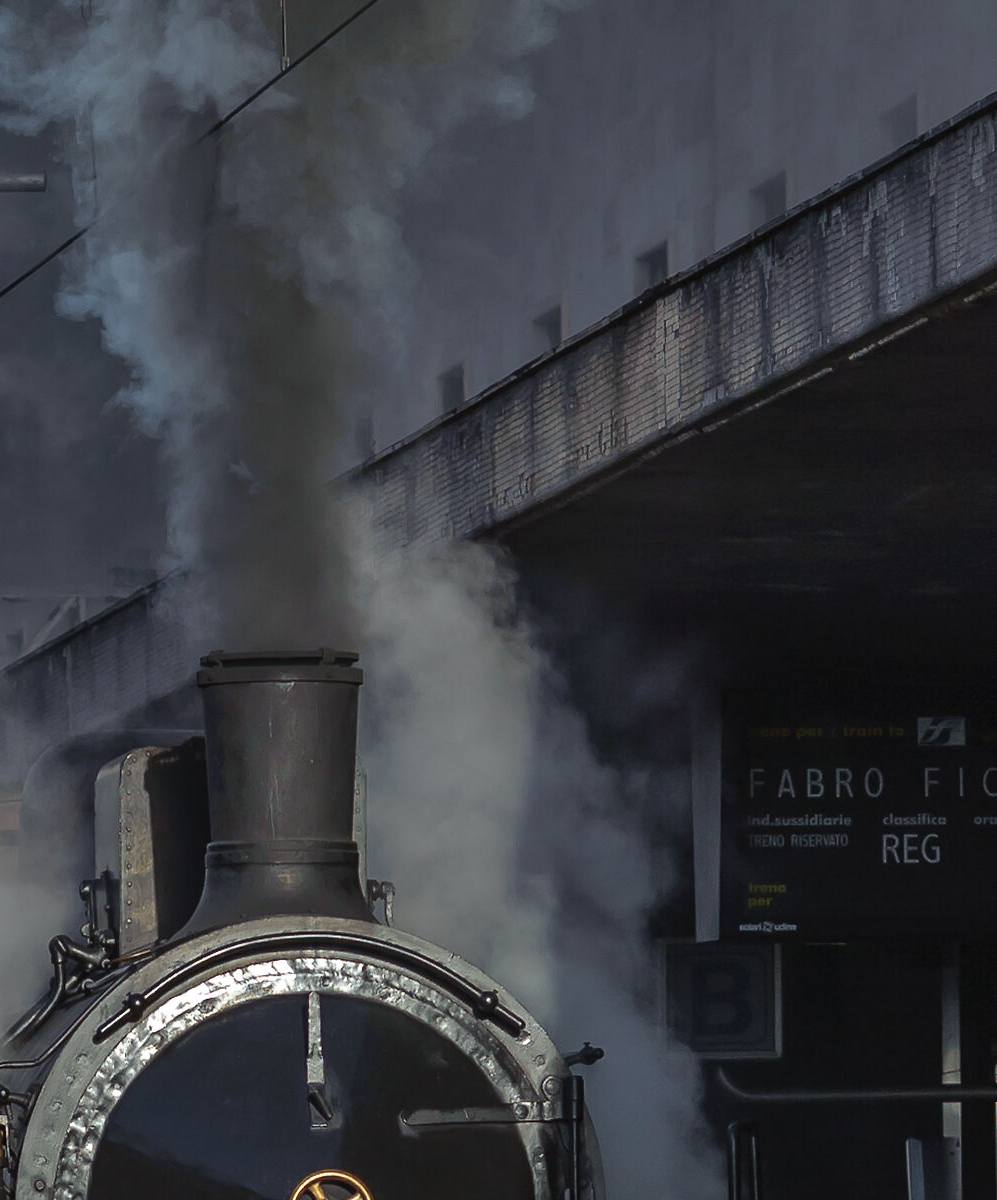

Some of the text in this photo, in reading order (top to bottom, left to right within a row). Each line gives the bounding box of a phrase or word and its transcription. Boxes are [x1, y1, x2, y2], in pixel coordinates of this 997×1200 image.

[842, 723, 883, 737] train
[889, 724, 905, 737] to
[749, 766, 997, 798] FABRO FIC
[747, 814, 852, 826] ind.sussidiarie
[882, 812, 947, 826] classifica
[749, 834, 849, 848] TRENO RISERVATO
[882, 833, 941, 864] REG
[749, 882, 787, 894] treno
[747, 896, 773, 908] per
[692, 960, 753, 1036] B
